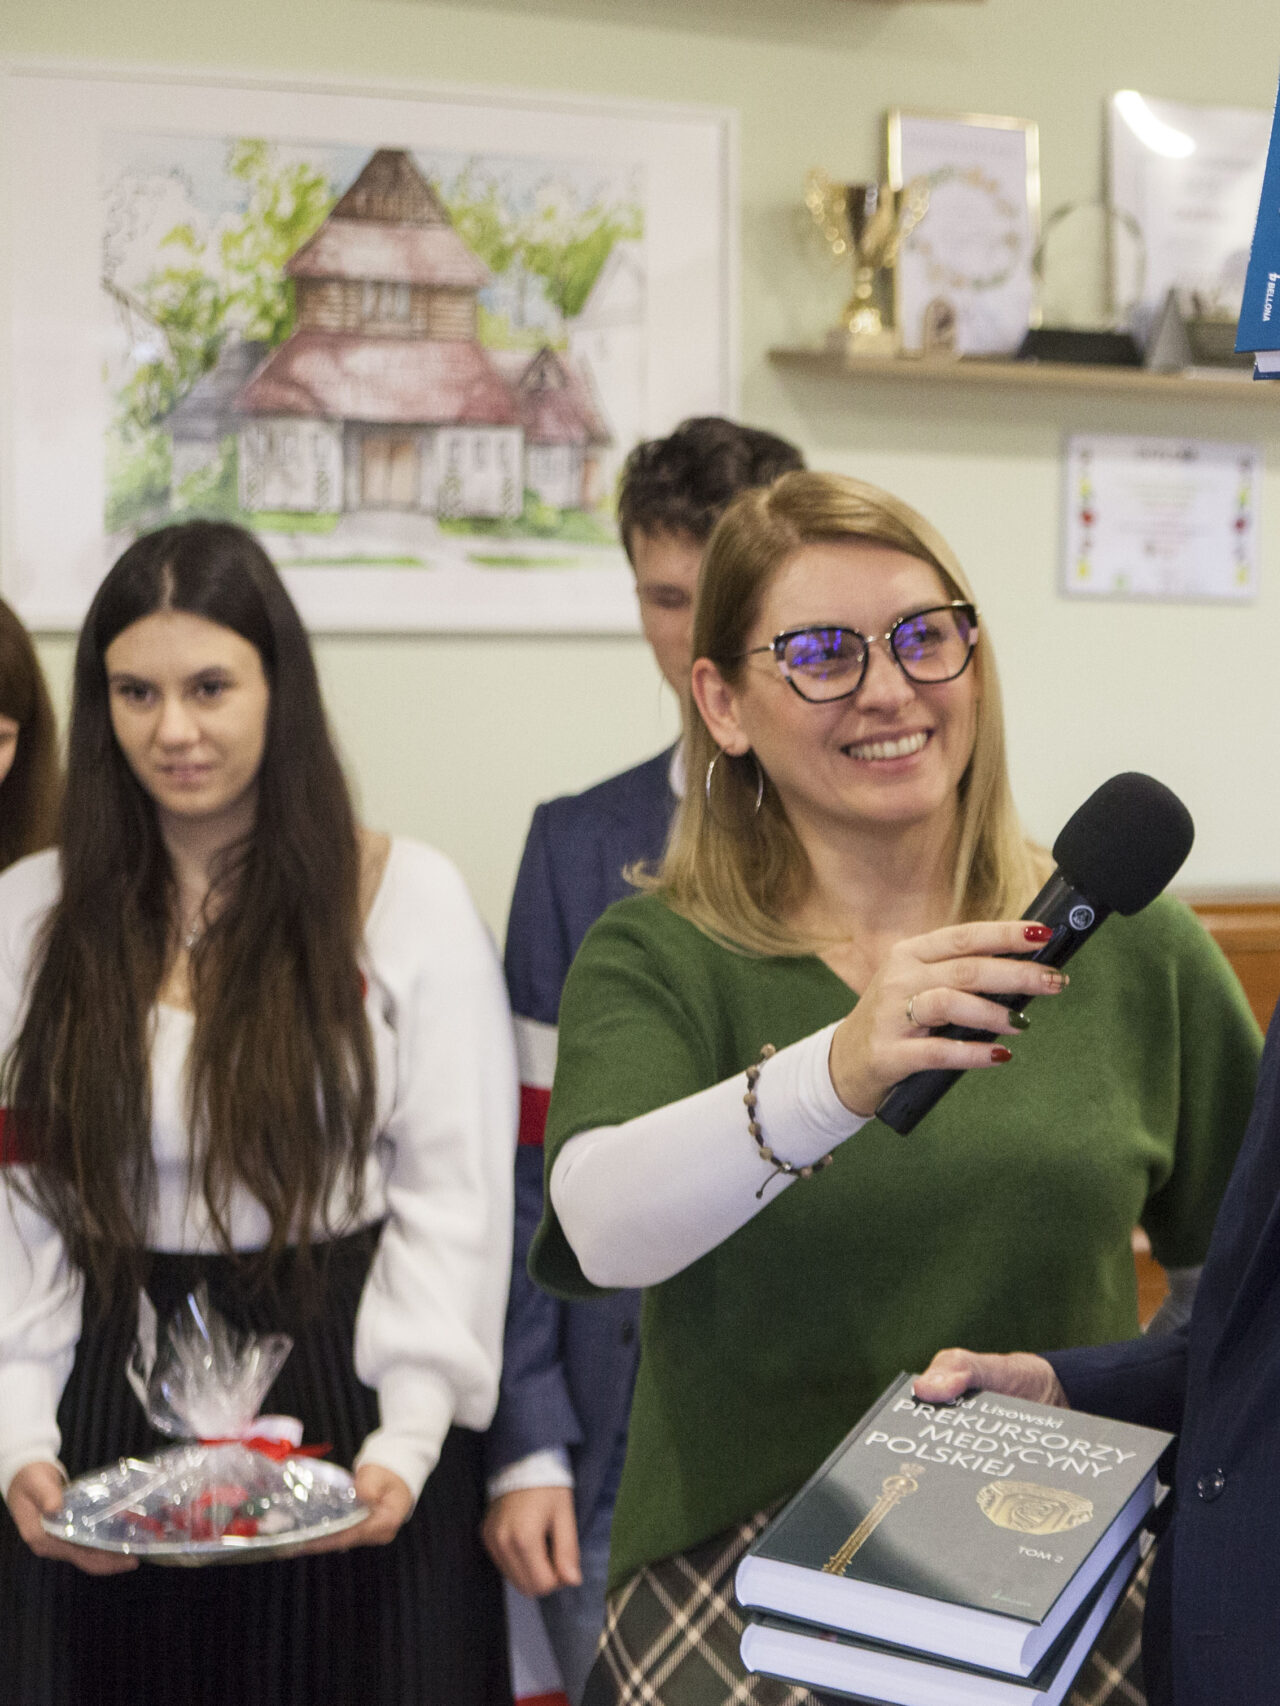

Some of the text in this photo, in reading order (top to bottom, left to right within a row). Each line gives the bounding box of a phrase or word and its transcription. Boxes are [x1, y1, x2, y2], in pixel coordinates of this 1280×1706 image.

[1262, 281, 1277, 322] BELLONA
[892, 1399, 1138, 1465] PREKURSORZY
[980, 1402, 1065, 1430] Lisowski
[864, 1430, 1016, 1478] POLSKIEJ
[917, 1425, 1114, 1479] MEDYCYNY
[1019, 1545, 1052, 1561] TOM
